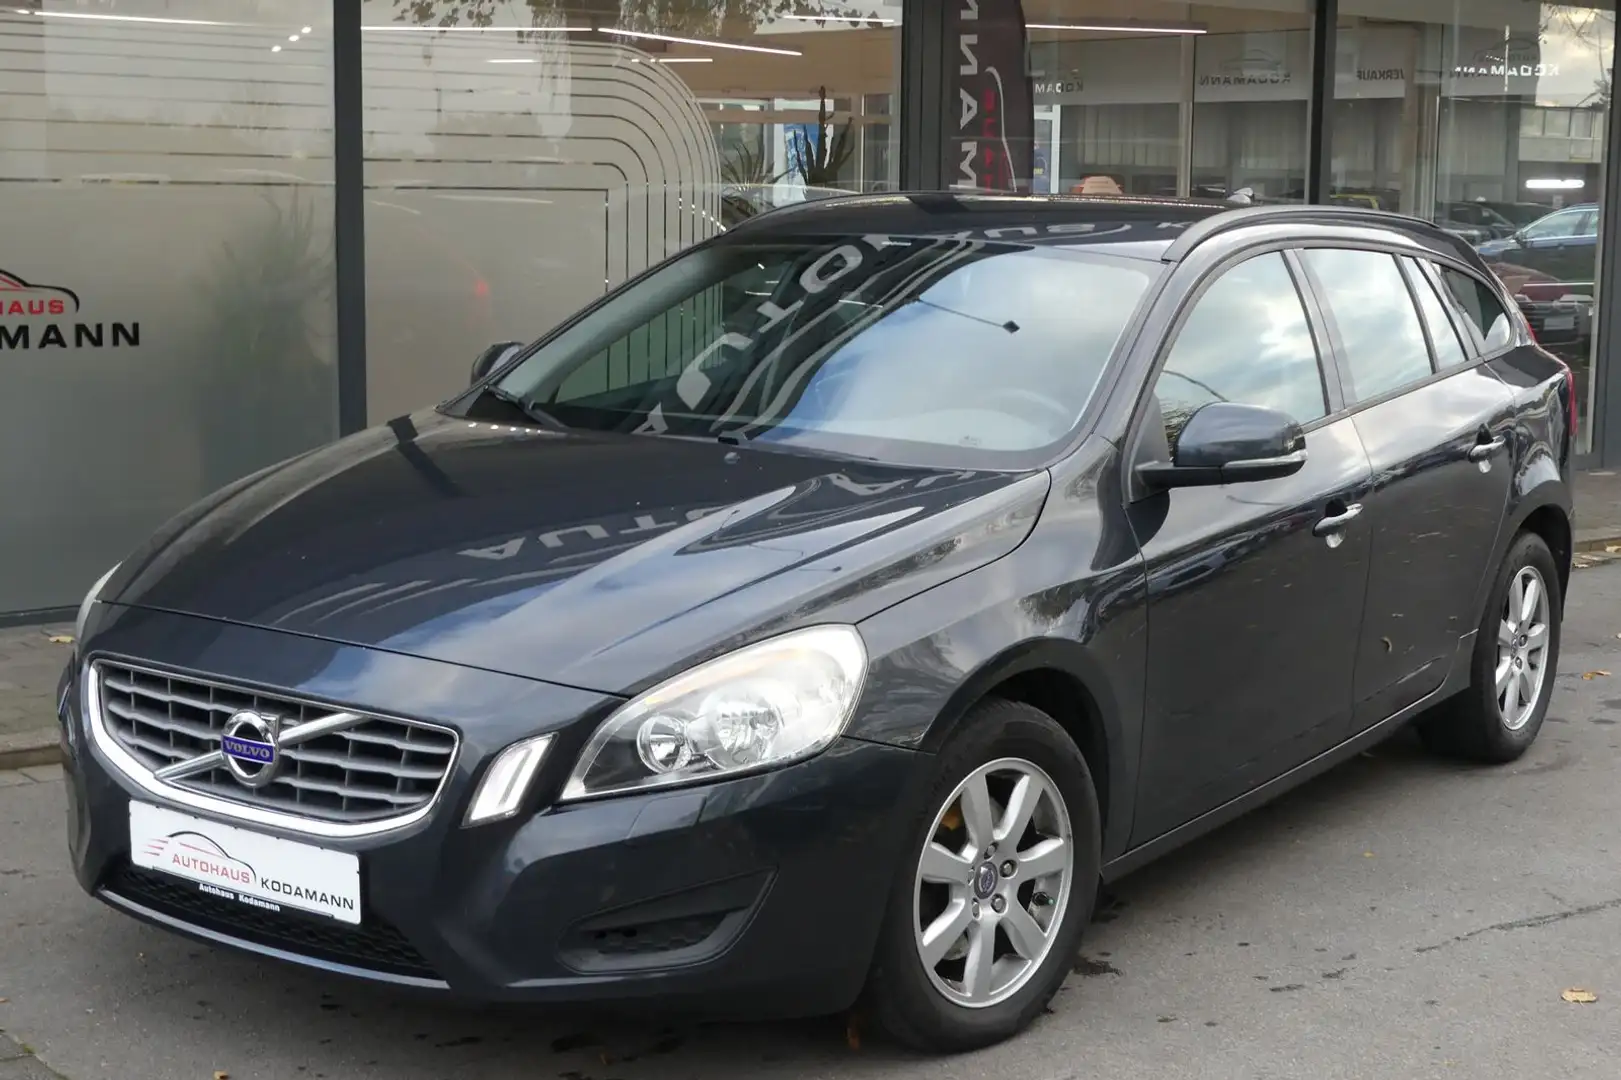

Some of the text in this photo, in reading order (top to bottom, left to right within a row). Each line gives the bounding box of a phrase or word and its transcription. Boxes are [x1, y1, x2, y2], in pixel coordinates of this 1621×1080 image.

[0, 298, 65, 315] AUS
[224, 740, 271, 759] VOLVO
[172, 853, 355, 911] AUTOHAUS KODAMANN
[199, 883, 281, 912] Autohaus Kodamann
